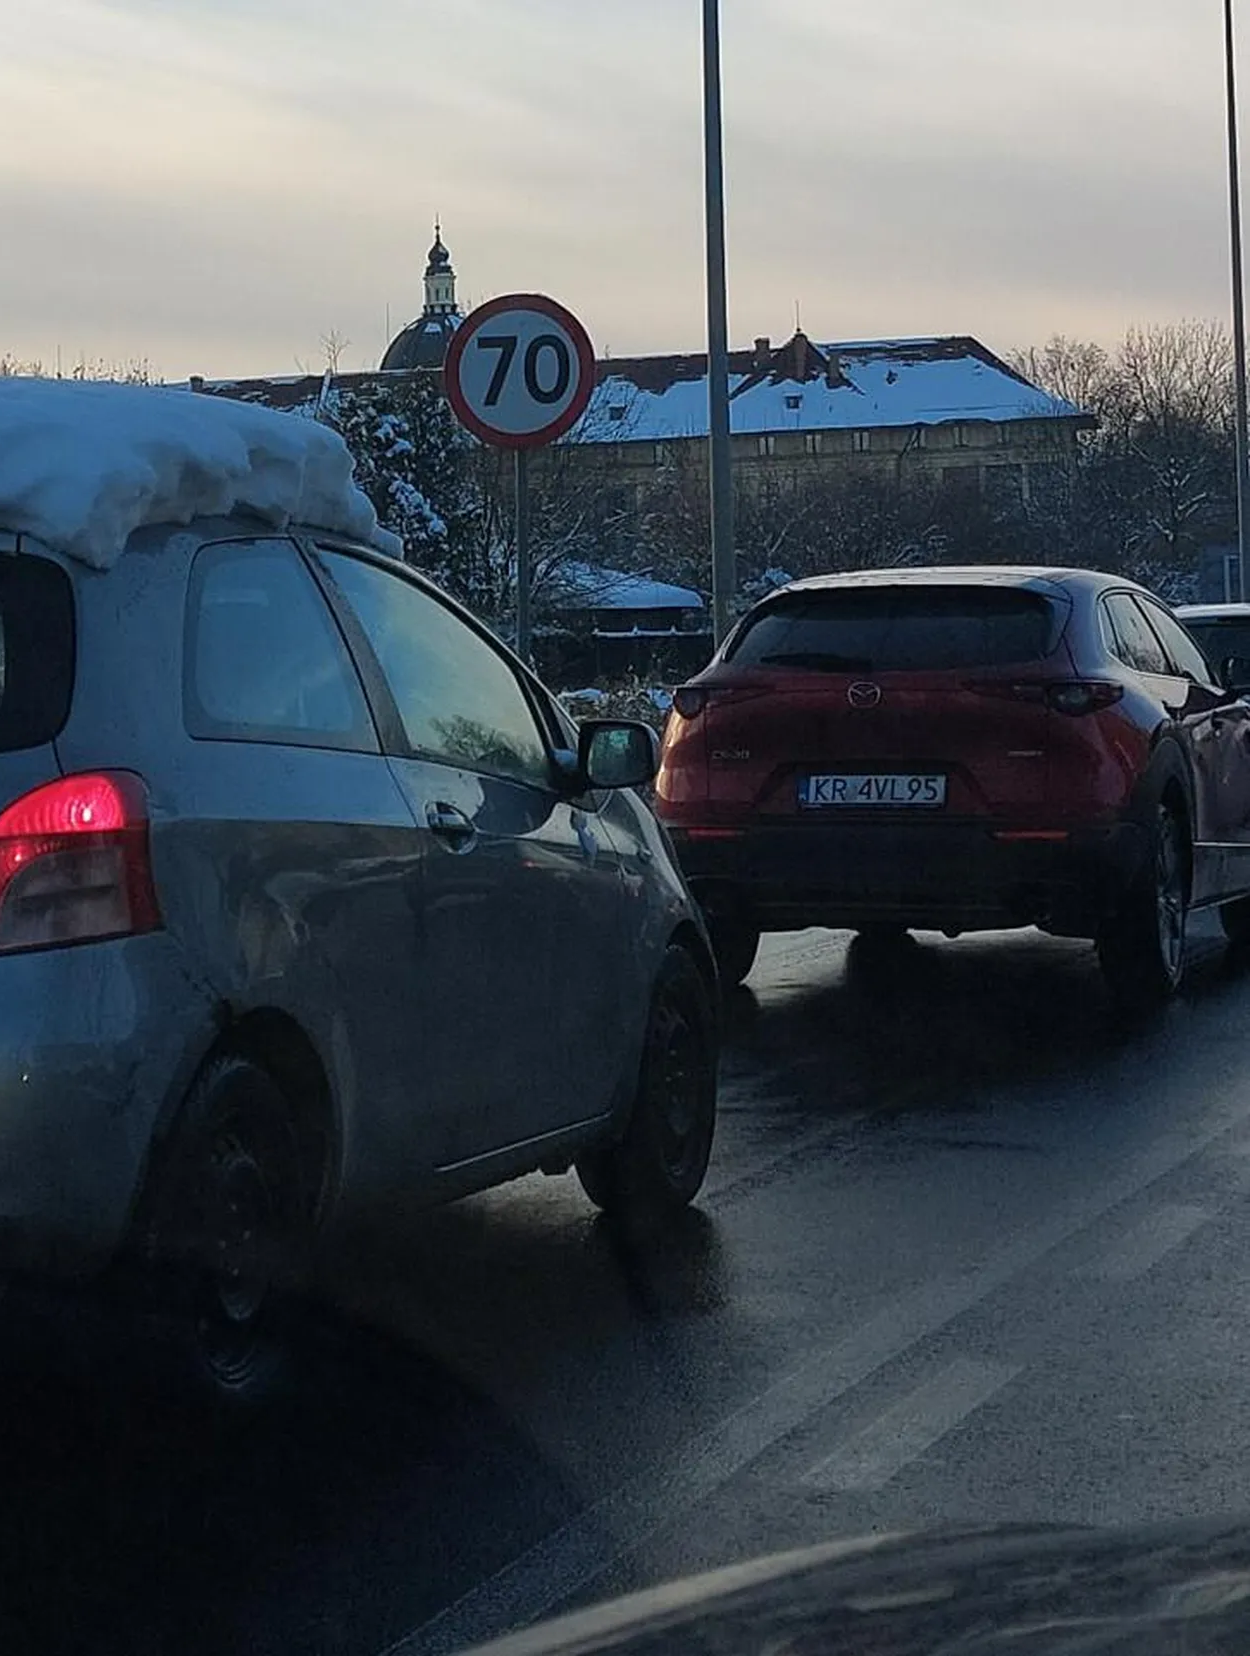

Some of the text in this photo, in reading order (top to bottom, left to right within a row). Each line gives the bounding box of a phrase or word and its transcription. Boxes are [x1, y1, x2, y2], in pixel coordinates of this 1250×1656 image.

[476, 334, 570, 406] 70
[814, 778, 938, 801] KR 4VL95
